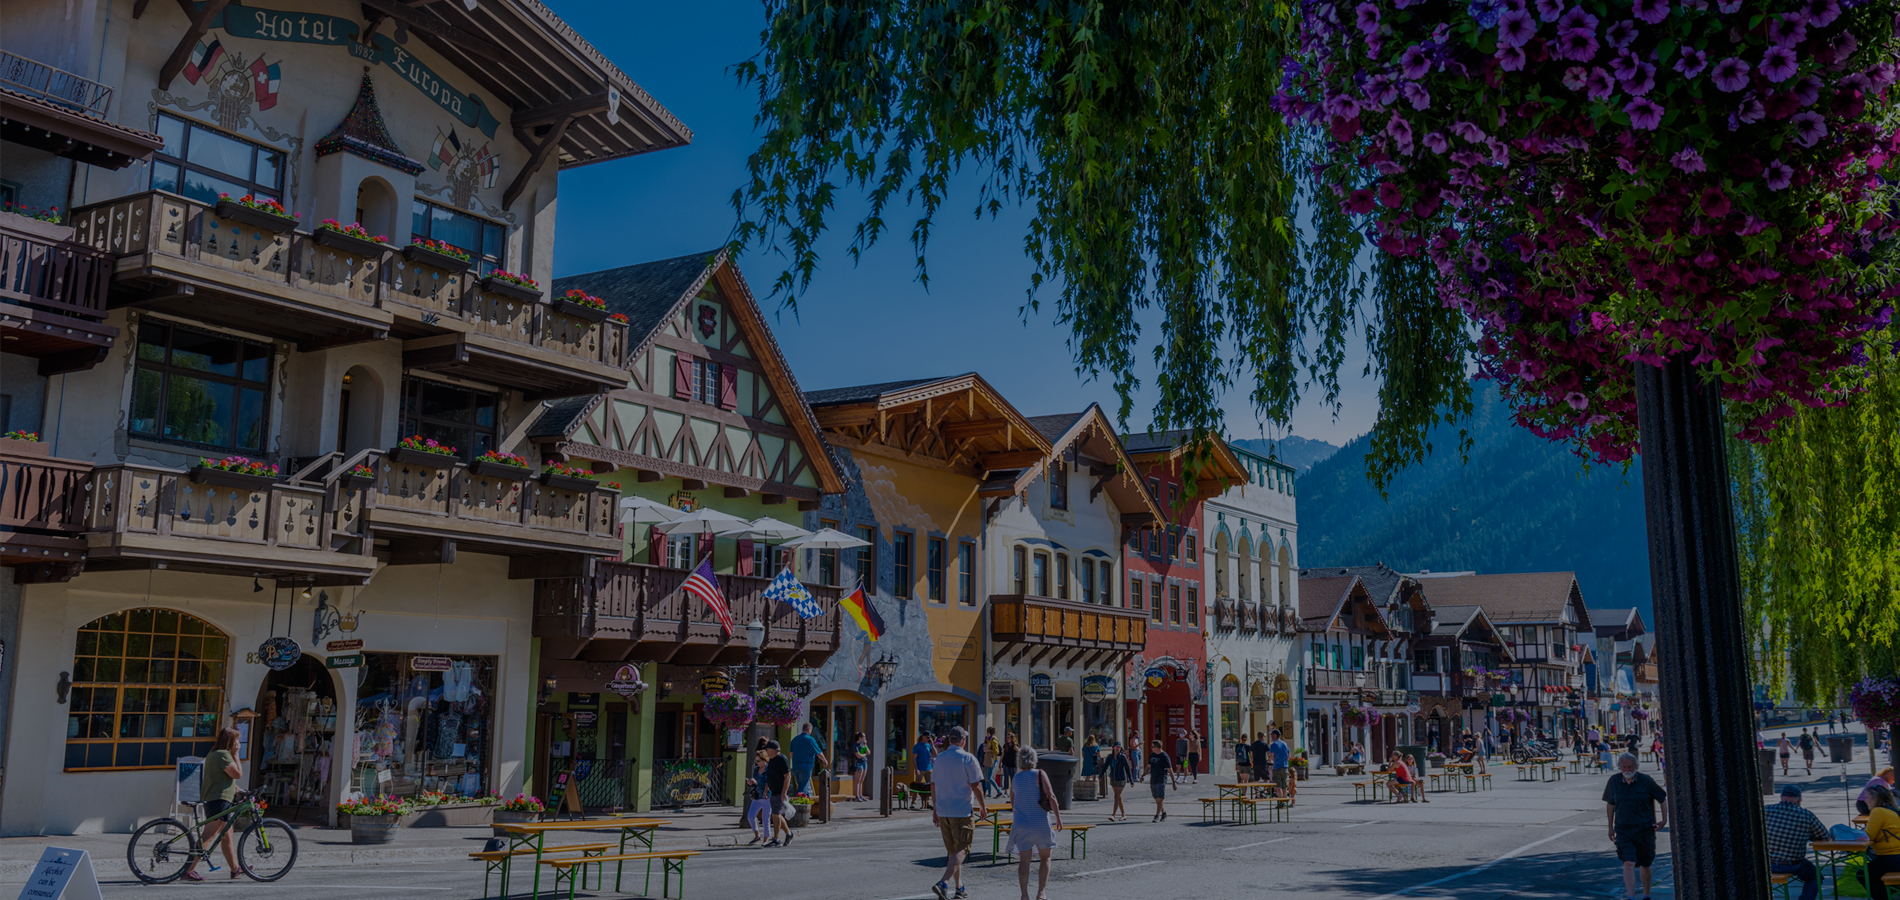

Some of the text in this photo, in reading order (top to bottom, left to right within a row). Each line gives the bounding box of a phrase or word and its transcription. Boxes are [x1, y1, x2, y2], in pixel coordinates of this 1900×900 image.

[255, 11, 338, 41] Hotel
[355, 44, 375, 60] 1982
[392, 46, 462, 116] Europa
[246, 652, 264, 665] 83
[332, 657, 356, 667] Massage
